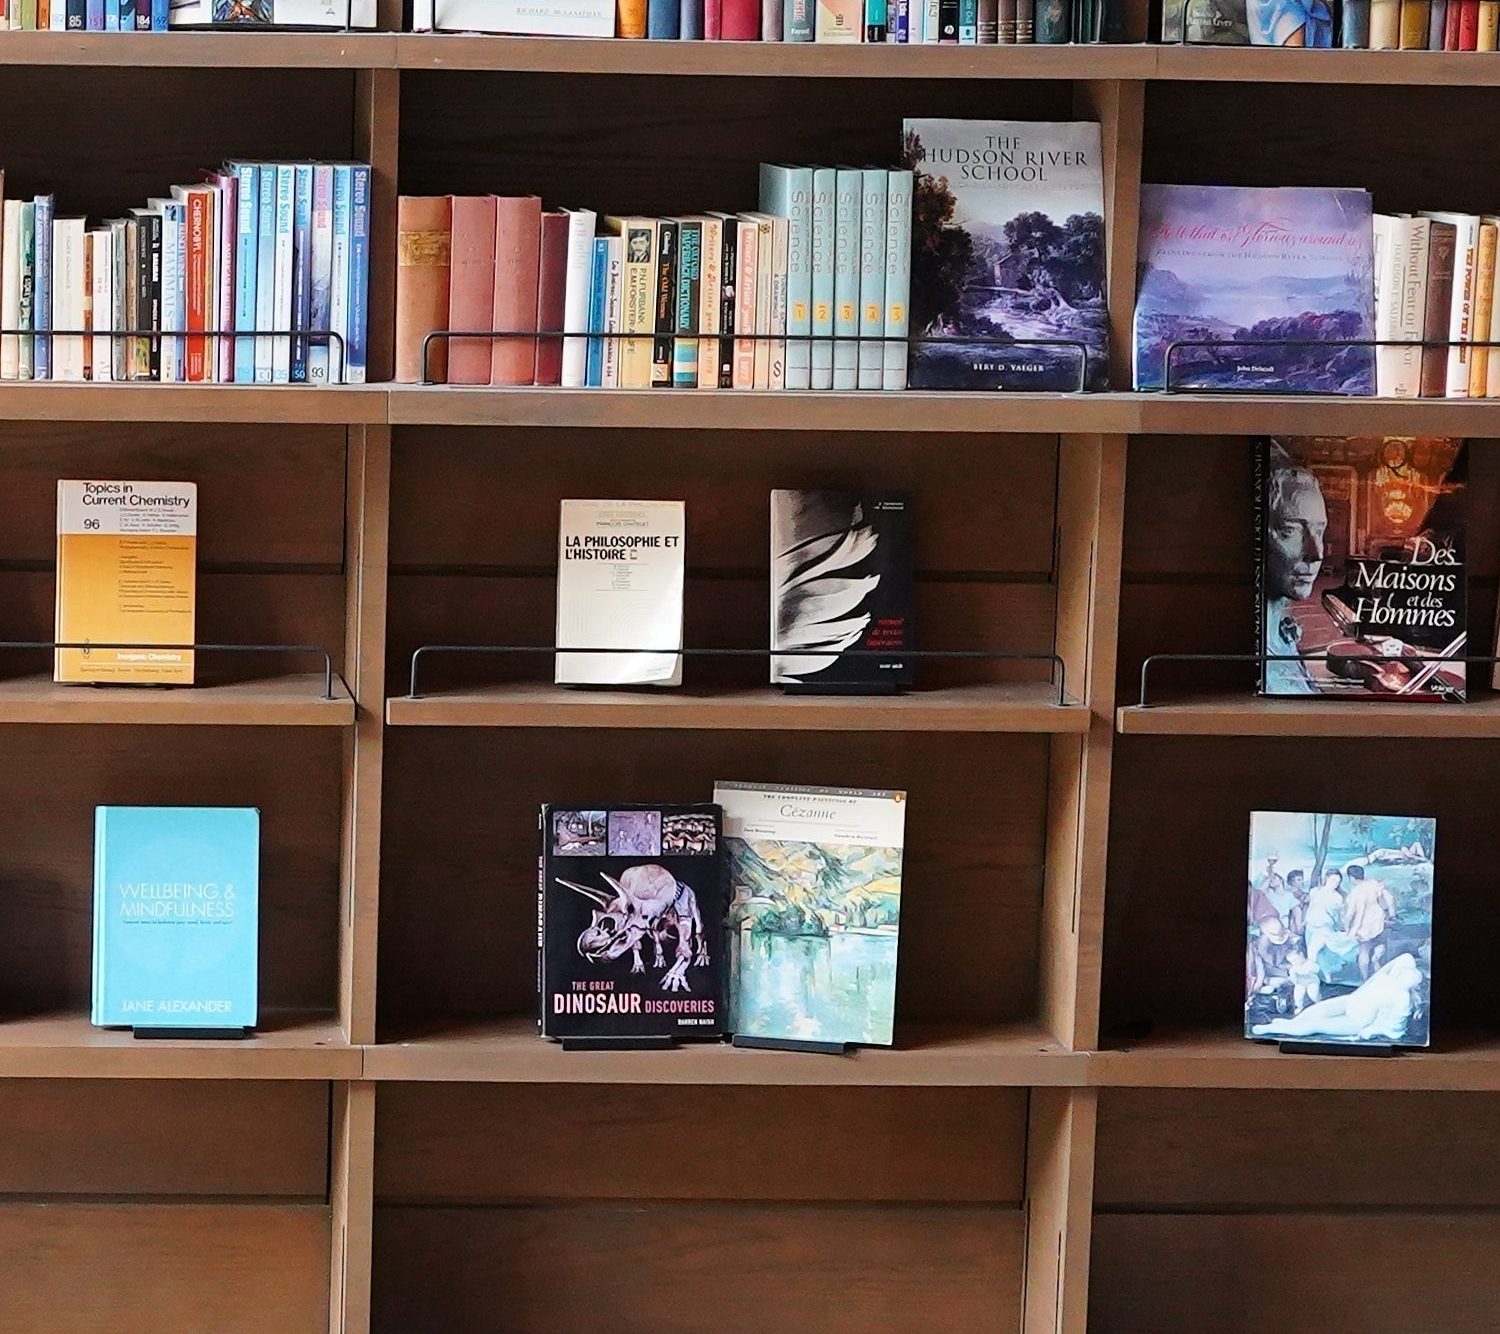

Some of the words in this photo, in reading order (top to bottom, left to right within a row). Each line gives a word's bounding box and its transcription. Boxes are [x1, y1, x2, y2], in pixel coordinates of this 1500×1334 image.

[985, 135, 1021, 150] THE
[923, 148, 1015, 166] HUDSON
[1024, 150, 1088, 167] RIVER
[959, 165, 1048, 183] SCHOOL
[565, 535, 579, 548] LA
[584, 535, 660, 548] PHILOSOPHIE
[664, 535, 679, 548] ET
[1411, 534, 1461, 567] Des
[565, 548, 626, 561] L'HISTOIRE
[1355, 566, 1456, 592] Maisons
[1353, 597, 1456, 628] Hommes
[120, 883, 219, 900] WELLBEING
[223, 883, 235, 899] &
[120, 902, 234, 918] MINDFULNESS
[553, 993, 641, 1015] DINOSAUR
[645, 1000, 715, 1015] DISCOVERIES
